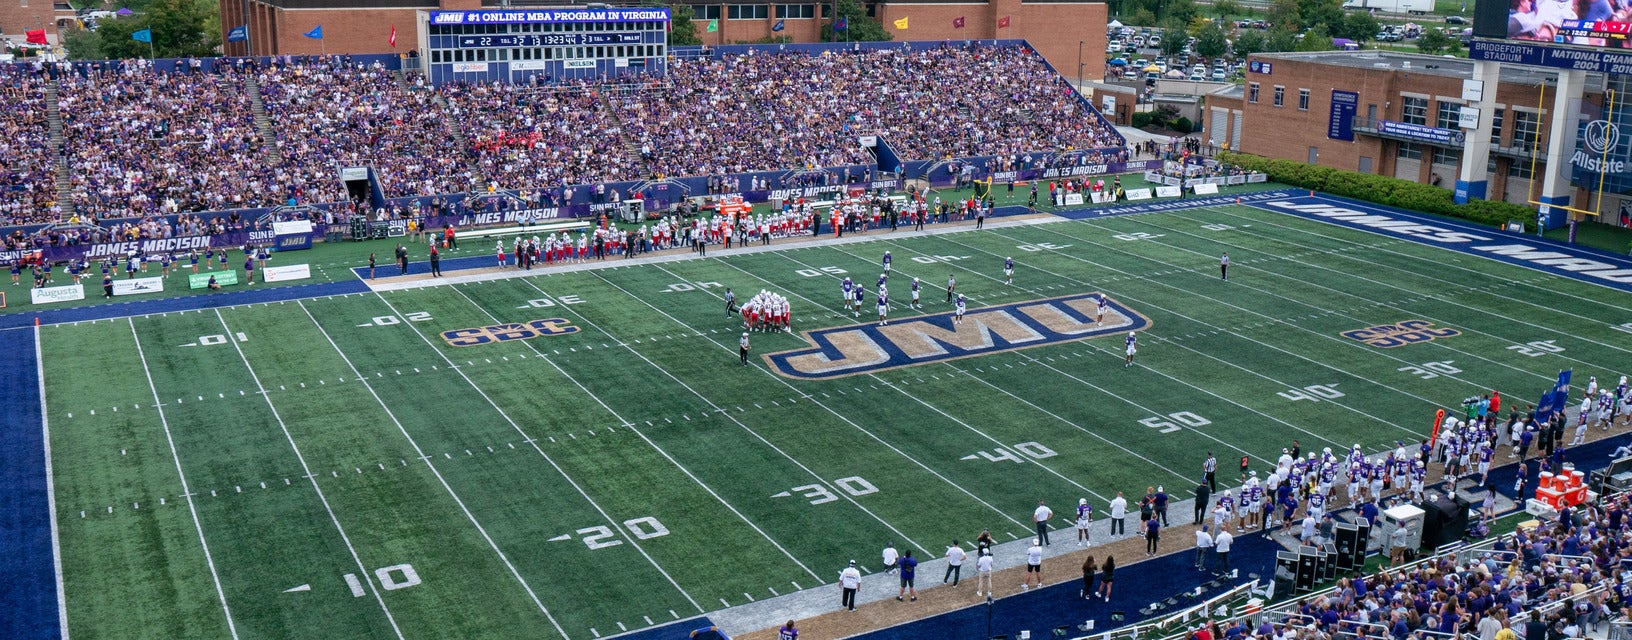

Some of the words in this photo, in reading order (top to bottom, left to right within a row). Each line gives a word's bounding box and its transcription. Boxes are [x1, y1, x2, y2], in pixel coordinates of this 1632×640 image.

[435, 13, 464, 23] JMU
[468, 13, 480, 22] #1
[482, 12, 525, 21] ONLINE
[527, 12, 551, 21] MBA
[554, 11, 606, 20] PROGRAM
[608, 11, 619, 20] IN
[622, 11, 667, 20] VIRGINIA
[1583, 21, 1595, 29] 22
[480, 37, 492, 46] 22
[544, 35, 564, 44] 13:23
[565, 37, 576, 45] 44
[1475, 42, 1533, 55] BRIDGEFORTH
[1484, 51, 1522, 62] STADIUM
[1551, 50, 1600, 62] NATIONAL
[1573, 61, 1600, 70] 2004
[1569, 150, 1624, 174] Allstate
[1043, 167, 1070, 178] JAMES
[1071, 164, 1108, 175] MADISON
[872, 181, 883, 189] SUN
[589, 203, 604, 212] SUN
[1094, 205, 1149, 215] ZANE
[1266, 201, 1494, 243] JAMES
[249, 230, 268, 240] SUN
[281, 236, 307, 247] JMU
[85, 241, 139, 257] JAMES
[142, 236, 211, 252] MADISON
[795, 266, 849, 278] 50
[36, 286, 78, 298] Augusta
[667, 281, 724, 292] 40
[528, 294, 587, 308] 30
[372, 311, 434, 326] 20
[198, 331, 249, 346] 10
[440, 318, 581, 347] SBC
[764, 293, 1149, 379] JMU
[1505, 341, 1566, 357] 20
[1397, 361, 1463, 380] 30
[1276, 384, 1346, 403] 40
[1137, 411, 1212, 434] 50
[977, 441, 1059, 464] 40
[1241, 456, 1248, 467] 2
[791, 475, 879, 505] 30
[576, 515, 670, 550] 20
[343, 563, 421, 598] 10
